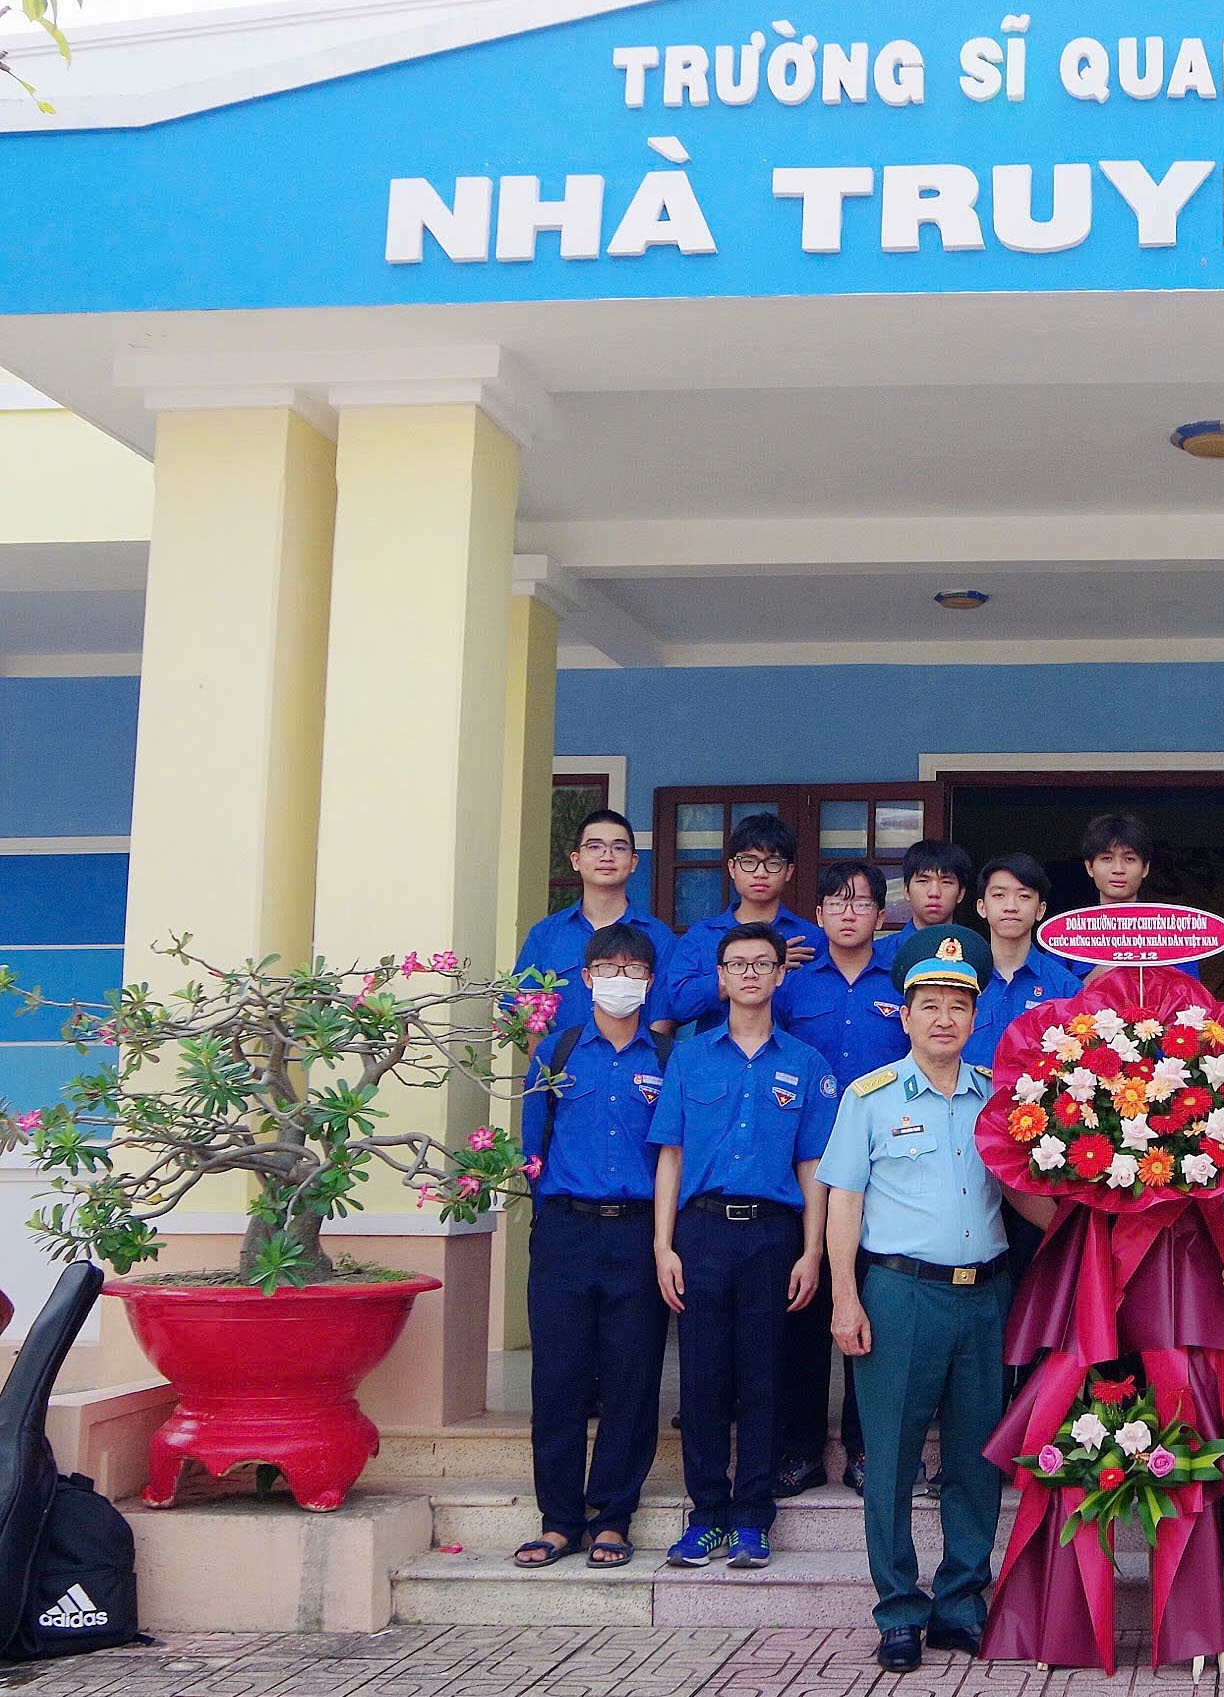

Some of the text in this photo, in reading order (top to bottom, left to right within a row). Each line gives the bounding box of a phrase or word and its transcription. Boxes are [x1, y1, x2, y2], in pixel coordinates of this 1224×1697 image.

[613, 20, 925, 108] TRƯỜNG
[959, 14, 1031, 102] SĨ
[385, 136, 719, 264] NHÀ
[1065, 913, 1208, 932] ĐOÀN TRƯỜNG THPT CHUYÊN LÊ QUÝ ĐÔN
[1048, 934, 1219, 948] CHÚC MỪNG NGÀY QUÂN ĐỘI NHÂN DÂN VIỆT NAM
[1112, 952, 1159, 960] 22-12
[39, 1610, 108, 1628] adidas
